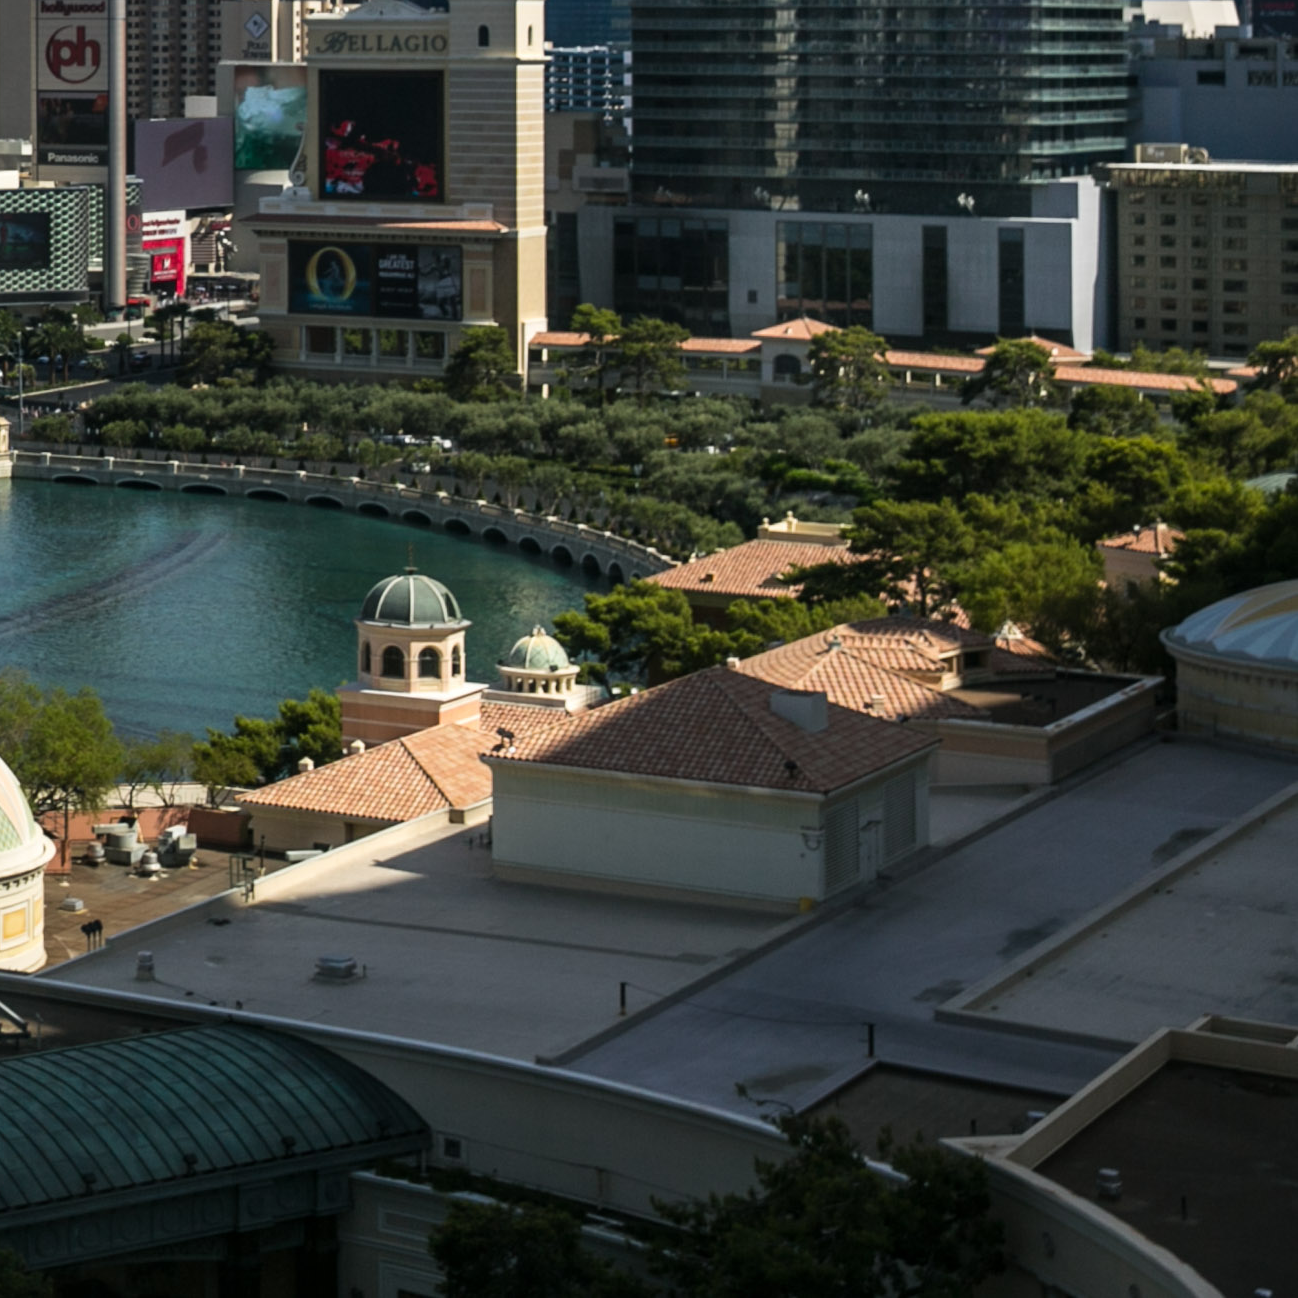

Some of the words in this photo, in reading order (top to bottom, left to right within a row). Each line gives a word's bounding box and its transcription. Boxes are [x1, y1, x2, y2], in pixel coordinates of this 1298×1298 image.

[40, 0, 106, 16] hollywood
[52, 25, 101, 78] ph
[316, 31, 447, 53] BELLAGIO
[48, 152, 99, 163] Panasonic
